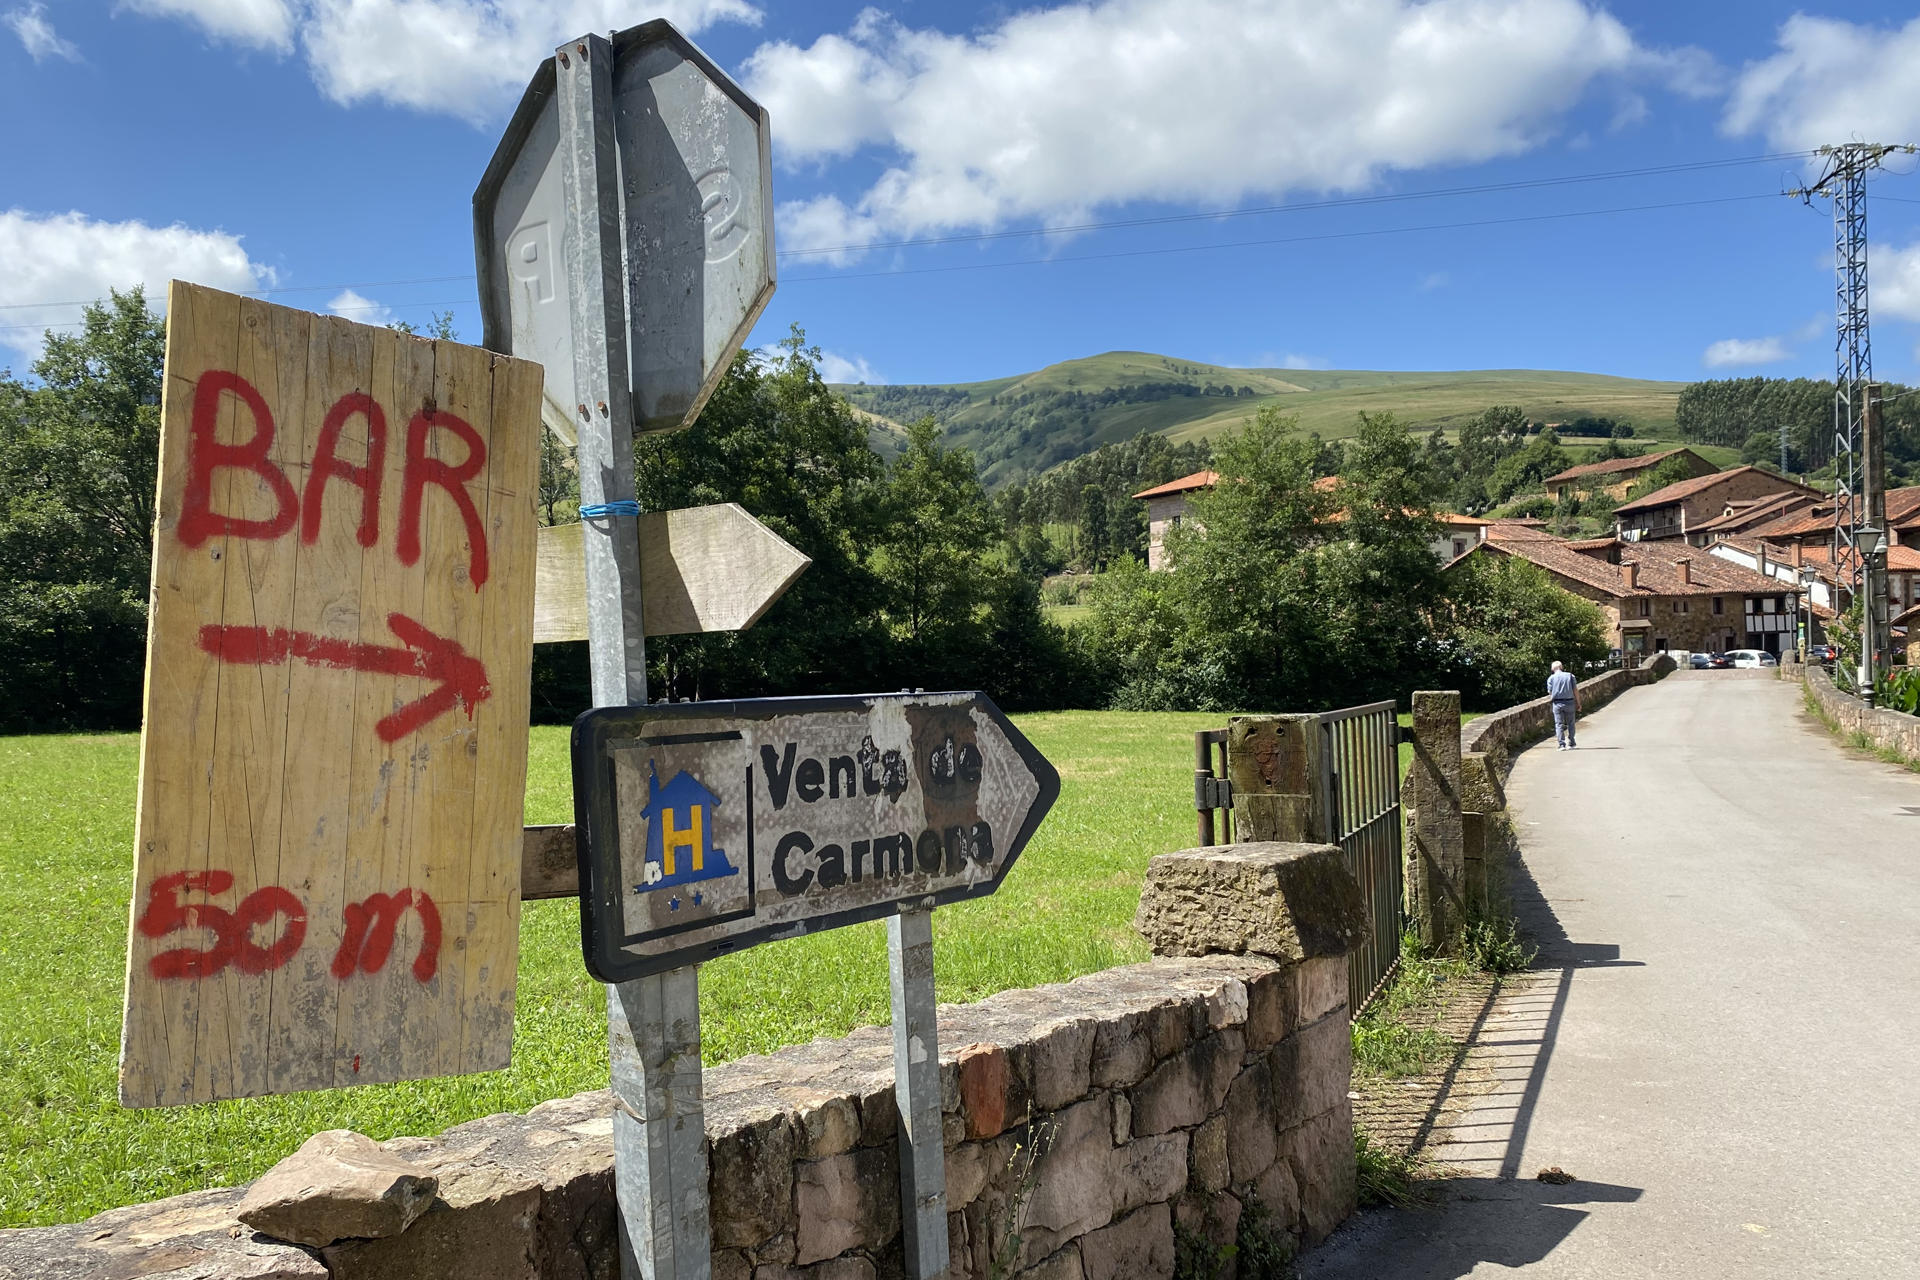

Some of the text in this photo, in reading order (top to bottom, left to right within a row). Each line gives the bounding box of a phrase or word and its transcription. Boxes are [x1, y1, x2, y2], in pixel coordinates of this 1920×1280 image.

[176, 369, 489, 592] BAR
[761, 735, 984, 811] Venta de
[661, 804, 704, 876] H
[771, 820, 995, 896] Carmona
[138, 869, 442, 984] 50 m
